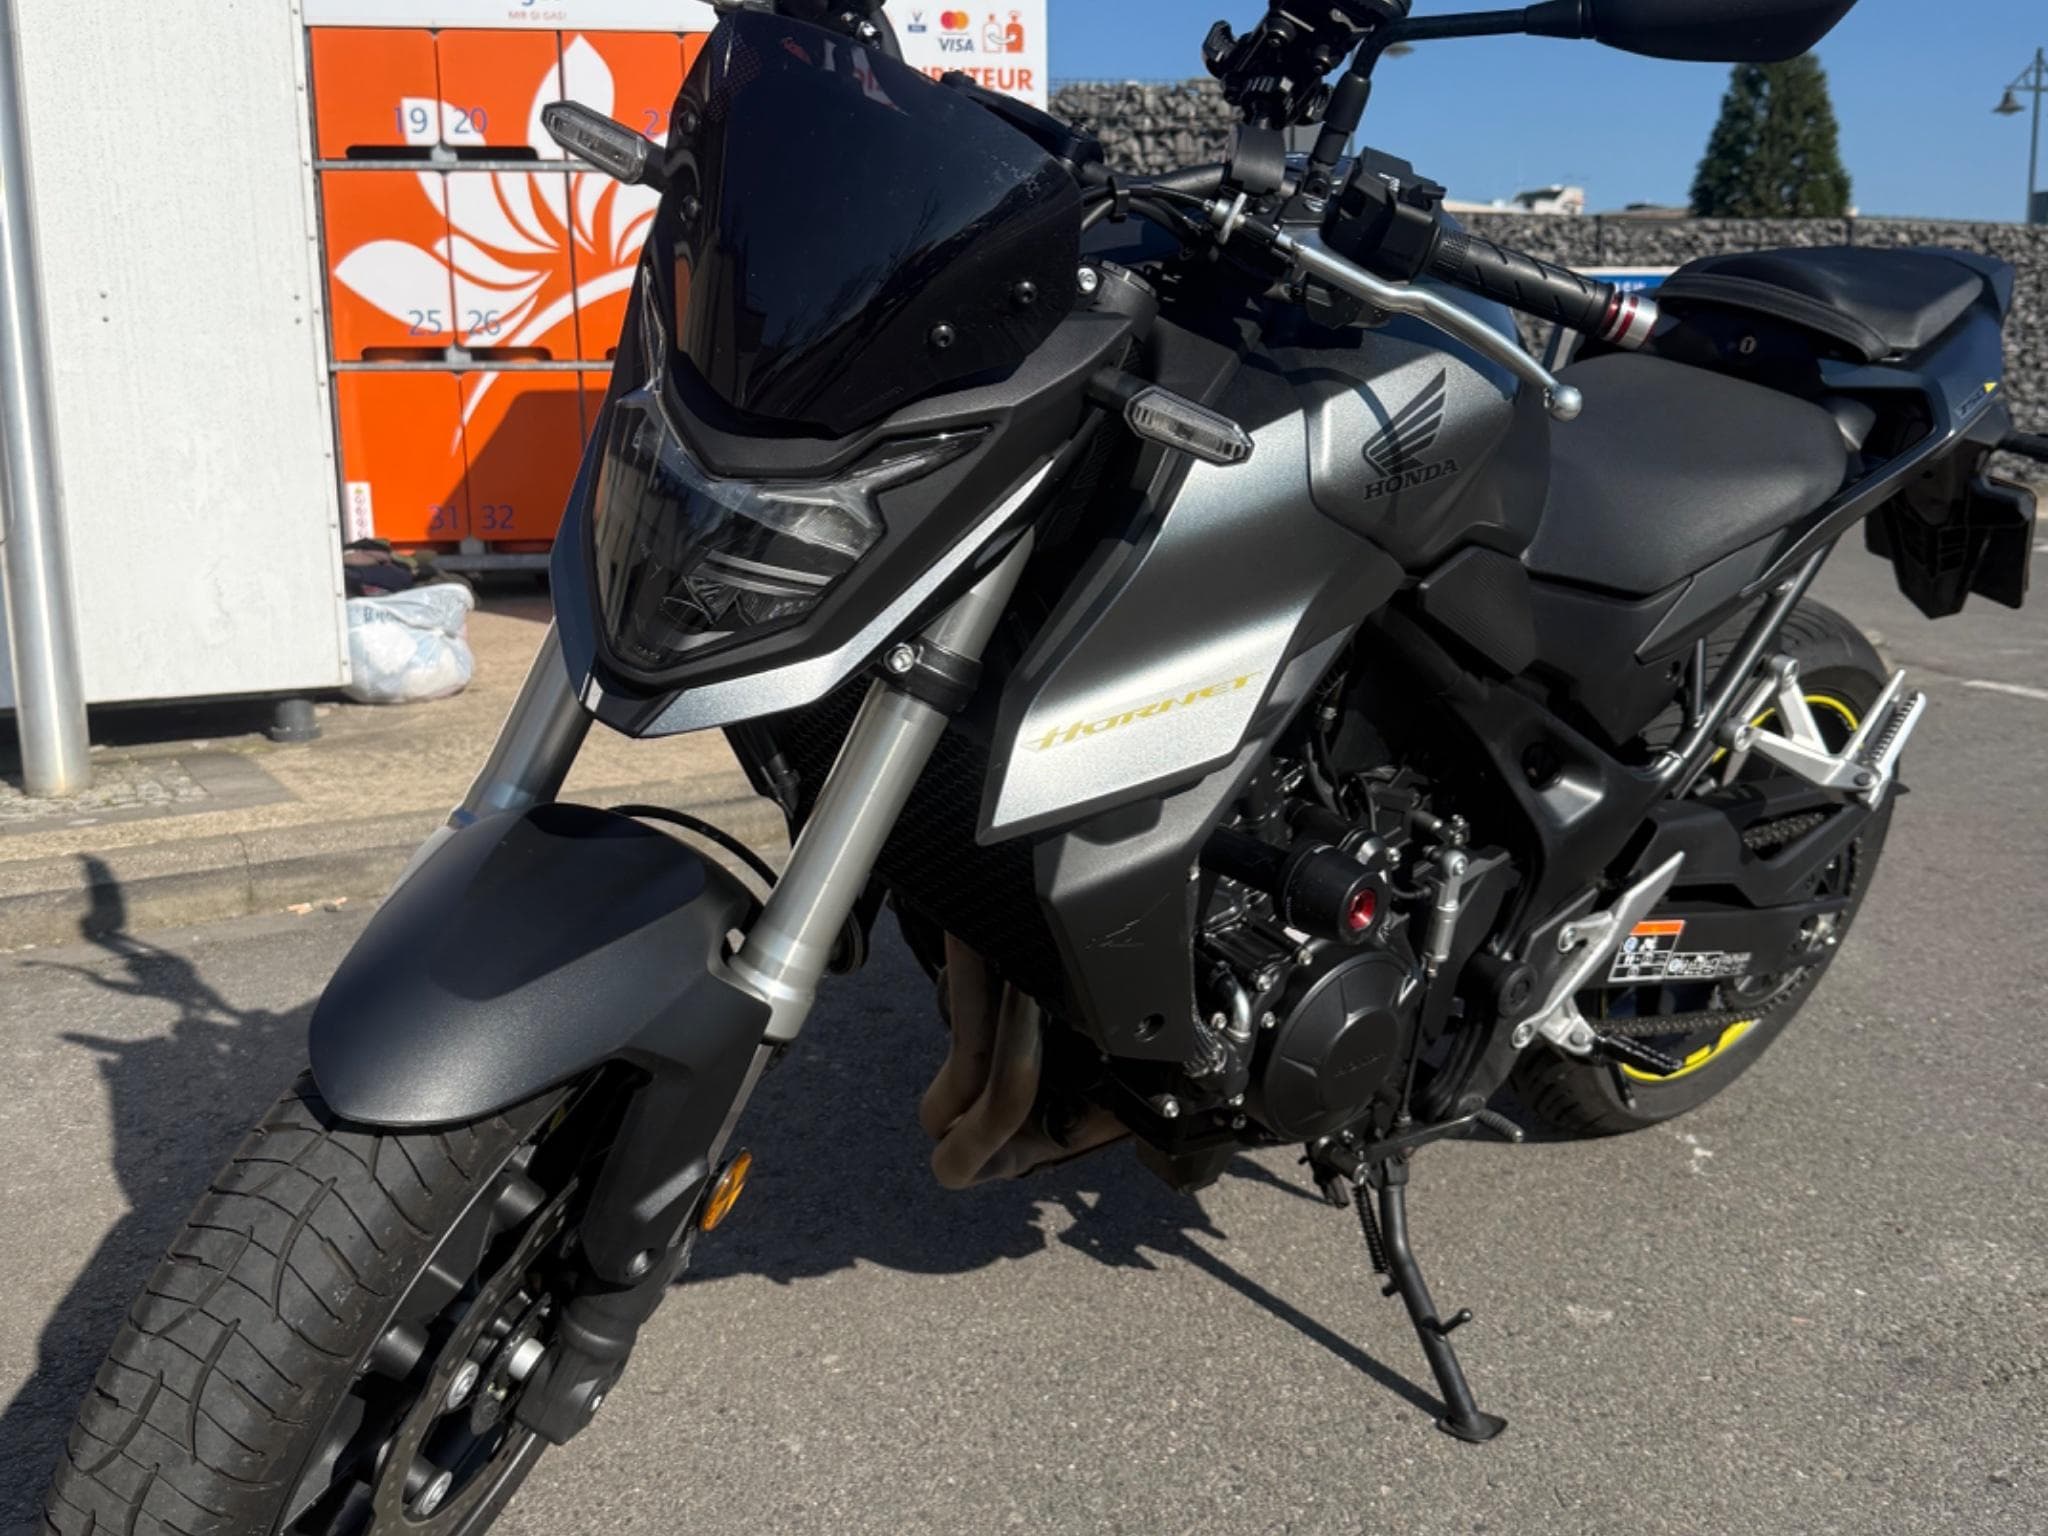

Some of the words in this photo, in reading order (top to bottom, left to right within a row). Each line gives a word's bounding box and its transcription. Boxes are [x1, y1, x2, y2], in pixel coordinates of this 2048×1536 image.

[939, 38, 975, 52] VISA
[393, 106, 428, 134] 19
[453, 107, 488, 134] 20
[408, 309, 443, 336] 25
[467, 309, 501, 336] 26
[1363, 459, 1459, 500] HONDA
[429, 505, 459, 531] 31
[480, 504, 515, 530] 32
[1021, 671, 1264, 752] HORNET
